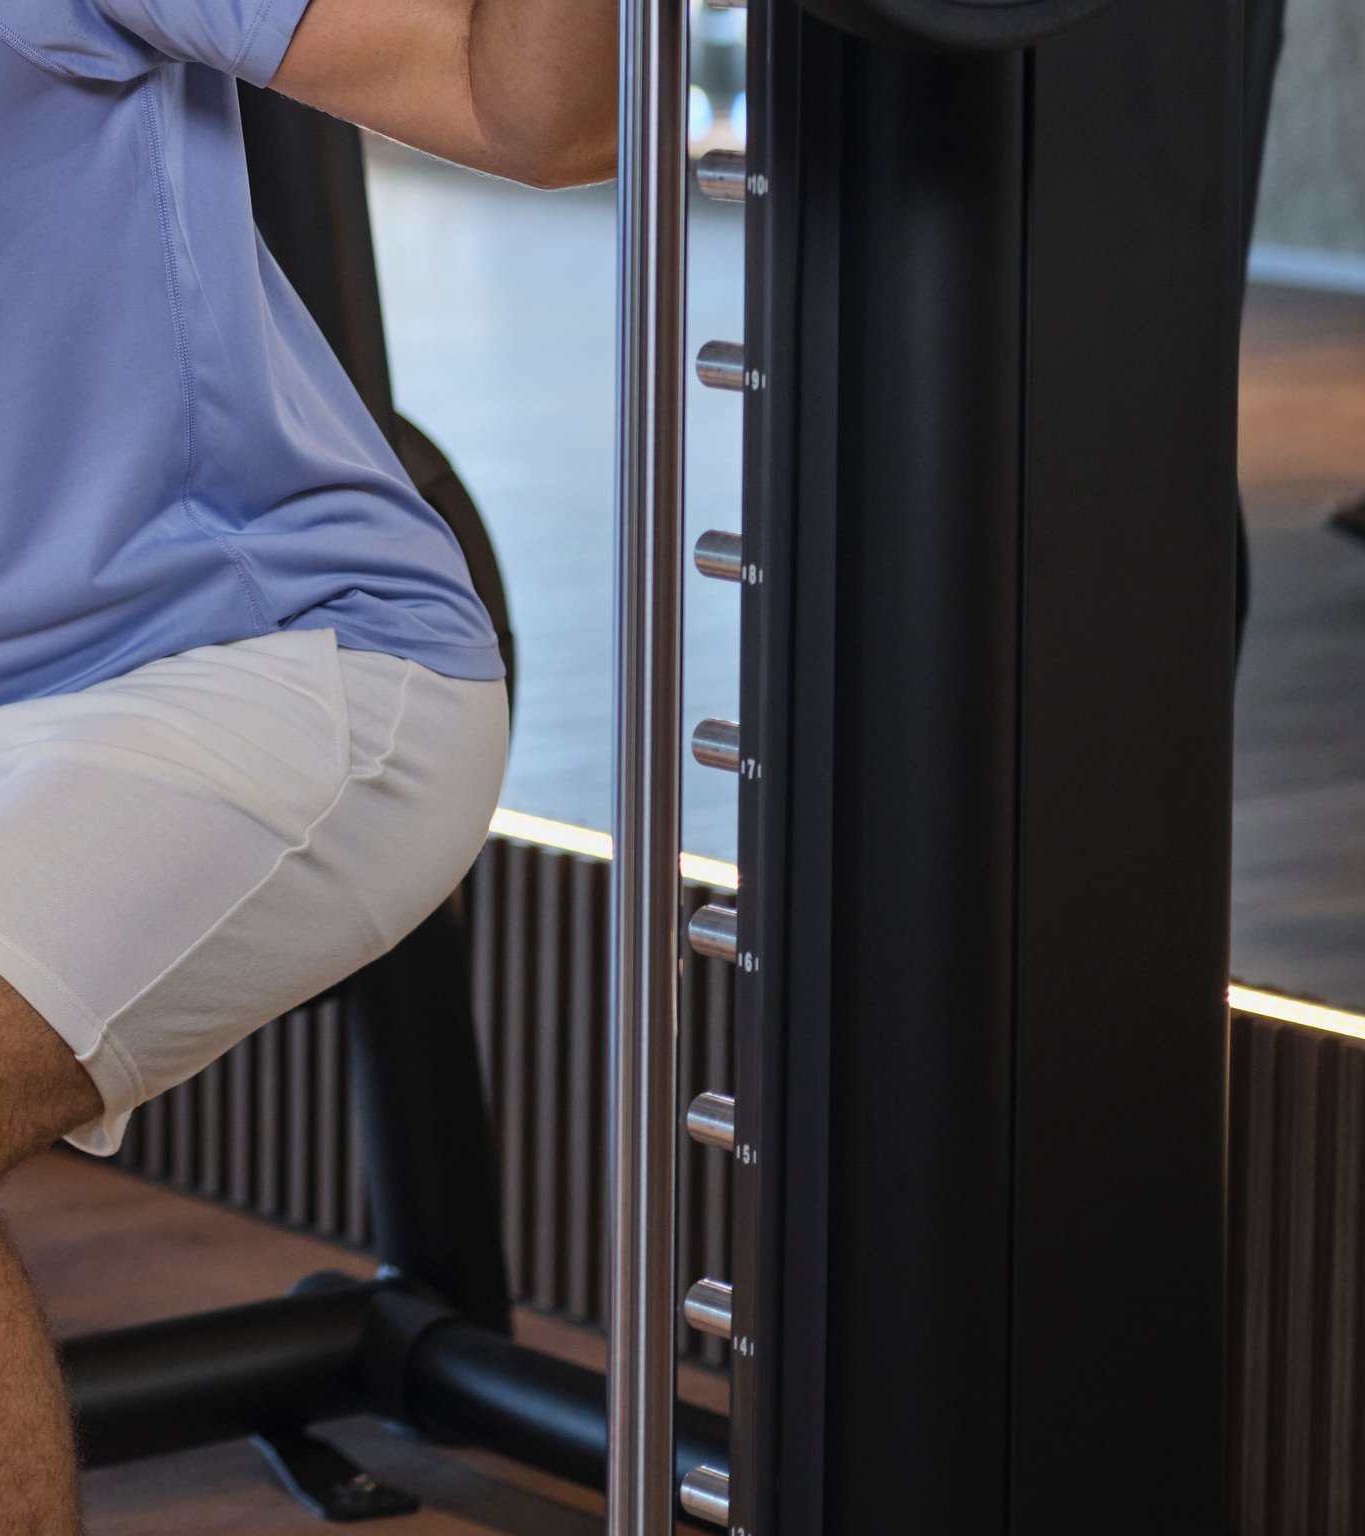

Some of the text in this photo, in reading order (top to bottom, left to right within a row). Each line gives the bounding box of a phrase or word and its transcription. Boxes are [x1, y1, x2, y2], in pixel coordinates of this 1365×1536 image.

[751, 369, 760, 391] 9
[748, 564, 757, 585] 8
[747, 759, 756, 780] 7
[744, 952, 753, 972] 6
[742, 1144, 750, 1164] 5
[739, 1336, 748, 1356] 4
